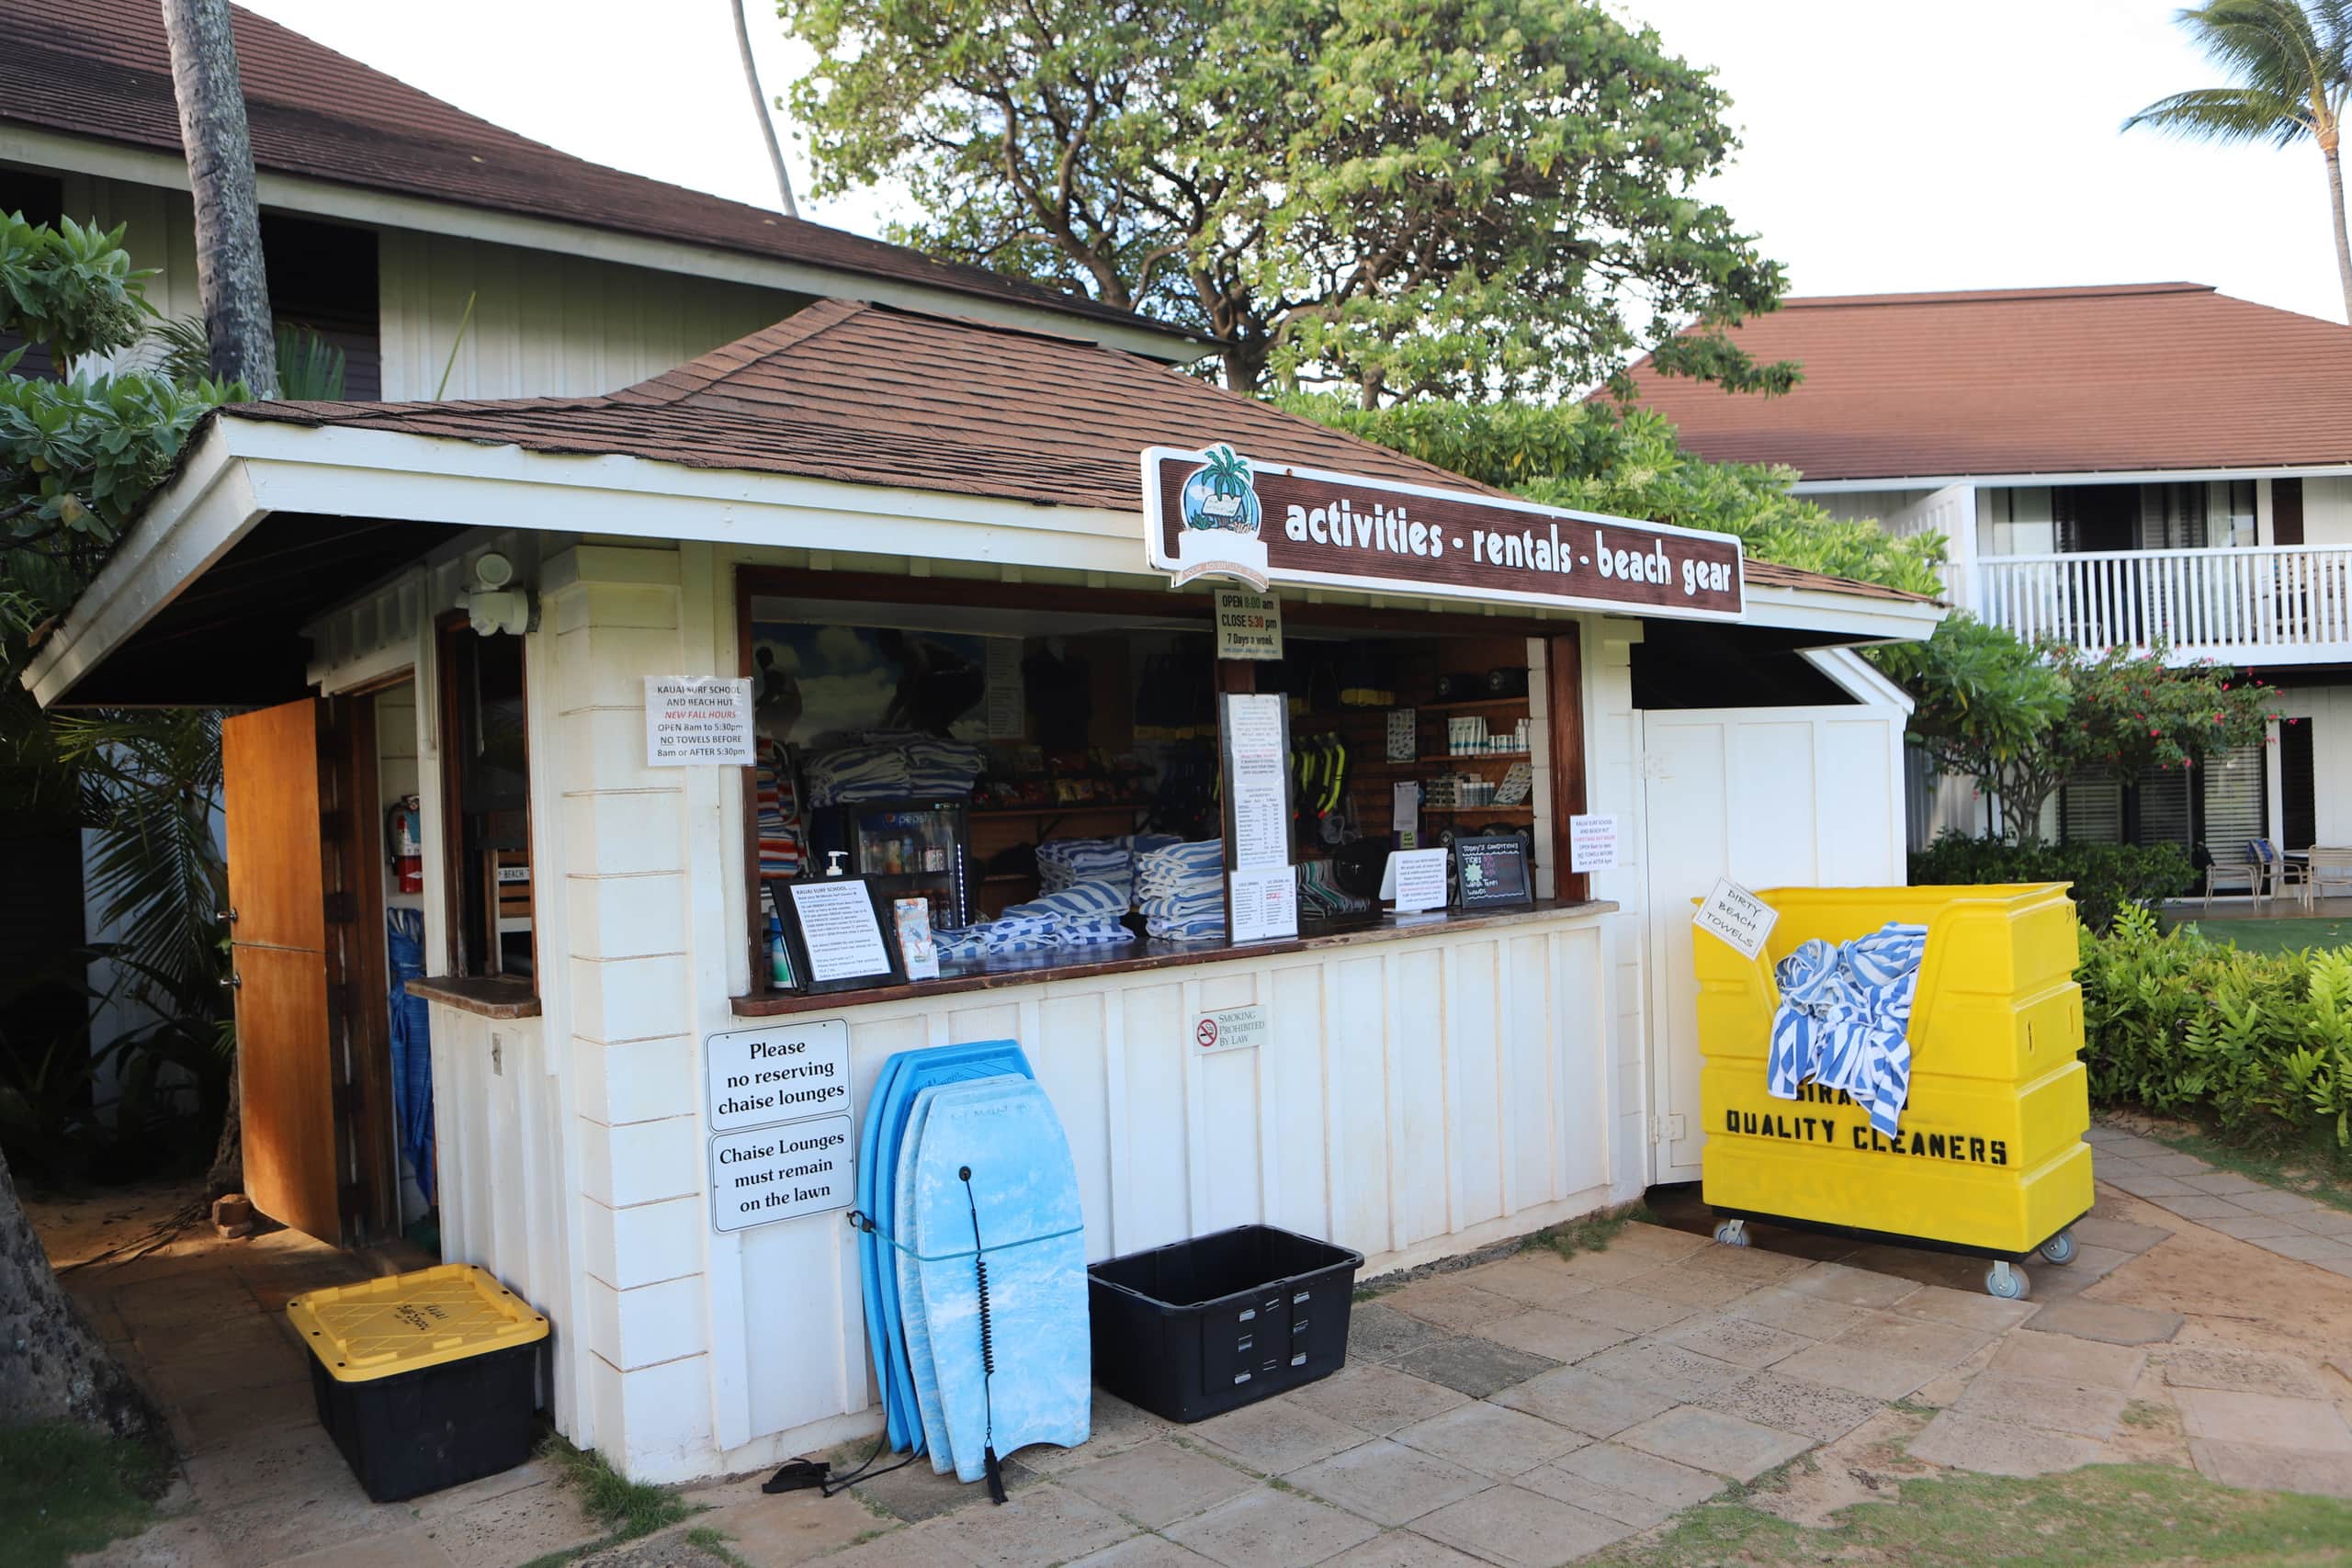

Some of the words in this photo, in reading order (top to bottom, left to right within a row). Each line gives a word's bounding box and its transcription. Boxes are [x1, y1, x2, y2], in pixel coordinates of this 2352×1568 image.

[1285, 499, 1443, 558] activities
[1473, 524, 1572, 573] rentals
[1595, 530, 1671, 585] beach
[1682, 558, 1731, 595] gear
[1222, 595, 1242, 608] OPEN
[1262, 601, 1273, 610] am
[1222, 614, 1246, 626] CLOSE
[1248, 615, 1264, 628] 5:30
[1265, 619, 1277, 631] pm
[1227, 633, 1232, 643] 7
[1233, 634, 1249, 647] Days
[1257, 636, 1273, 645] week
[658, 685, 684, 694] KAUAI
[687, 685, 707, 694] SURF
[709, 685, 741, 694] SCHOOL
[665, 711, 686, 719] NEW
[715, 723, 742, 732] 5:30pm
[718, 748, 745, 757] 5:30pm
[1727, 889, 1762, 917] DIRTY
[1718, 901, 1757, 931] BEACH
[1707, 912, 1754, 948] TOWELS
[1219, 1011, 1256, 1023] SMOKING
[1220, 1021, 1264, 1035] PROHIBITED
[1220, 1037, 1229, 1046] BY
[1231, 1035, 1248, 1044] LAW
[750, 1042, 806, 1059] Please
[728, 1075, 750, 1088] no
[755, 1062, 834, 1084] reserving
[718, 1095, 774, 1115] chaise
[779, 1084, 844, 1105] lounges
[1726, 1110, 1835, 1143] QUALITY
[1853, 1126, 2007, 1166] CLEANERS
[719, 1145, 774, 1165] Chaise
[779, 1133, 844, 1154] Lounges
[735, 1169, 774, 1188] must
[779, 1159, 832, 1179] remain
[740, 1200, 760, 1213] on
[765, 1191, 789, 1208] the
[795, 1186, 831, 1201] lawn
